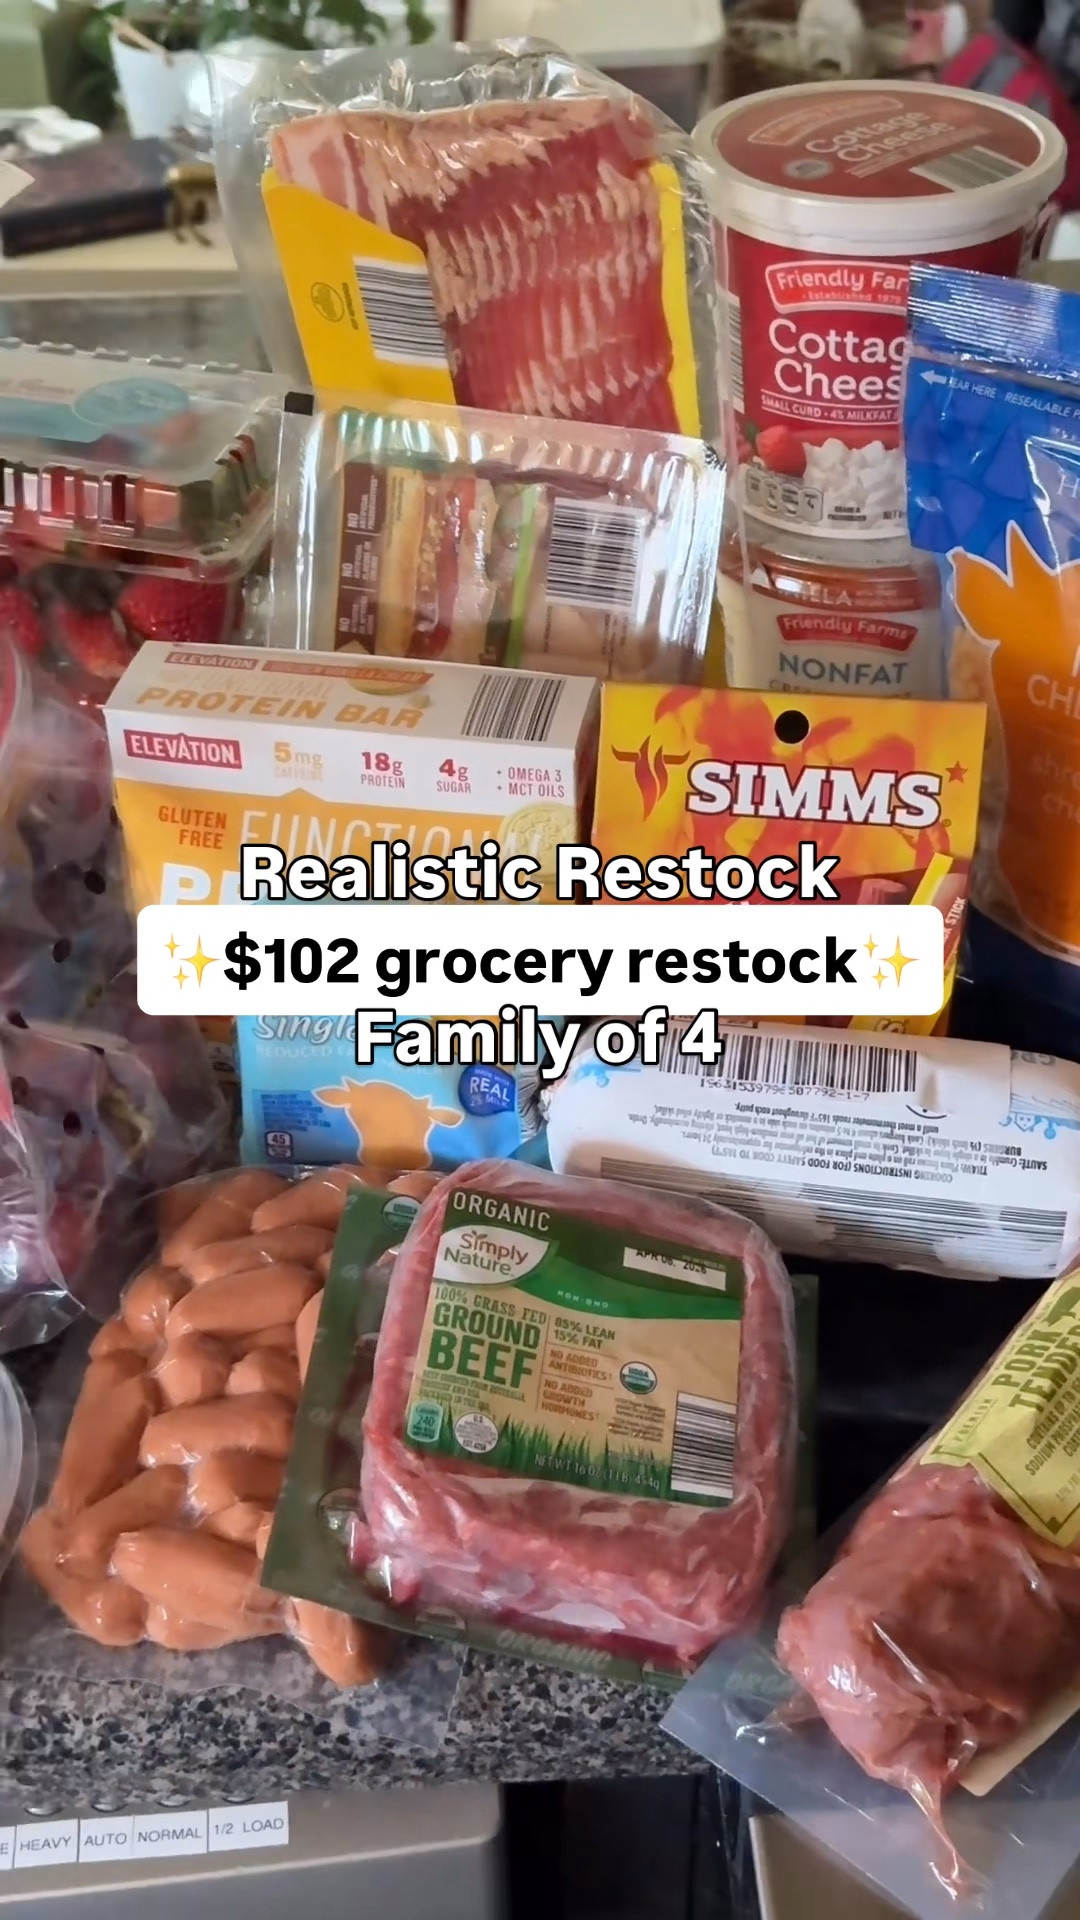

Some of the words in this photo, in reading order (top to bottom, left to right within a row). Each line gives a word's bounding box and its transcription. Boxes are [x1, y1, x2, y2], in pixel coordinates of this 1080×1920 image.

[806, 112, 930, 153] Cottage
[837, 122, 955, 162] Cheese
[776, 269, 864, 291] Friendly
[769, 318, 908, 371] Cottag
[774, 358, 903, 401] Chees
[761, 394, 790, 412] SMALL
[793, 403, 821, 418] CURD
[847, 408, 892, 421] MILKFAT
[971, 384, 998, 399] HERE
[1004, 391, 1070, 418] RESEALABLE
[784, 616, 852, 634] Friendly
[857, 621, 909, 640] Farms
[169, 653, 255, 669] ELEVATION
[778, 653, 909, 686] NONFAT
[137, 687, 327, 720] PROTEIN
[334, 704, 424, 729] BAR
[130, 734, 240, 765] ELEVATION
[361, 752, 404, 776] 18g
[438, 758, 469, 782] 4g
[507, 766, 551, 782] OMEGA
[554, 769, 563, 782] 3
[360, 774, 406, 789] PROTEIN
[436, 780, 471, 794] SUGAR
[508, 783, 534, 797] MCT
[537, 785, 566, 798] OILS
[686, 760, 943, 828] SIMMS
[157, 804, 227, 831] GLUTEN
[178, 829, 225, 851] FREE
[945, 896, 967, 925] STICK
[470, 1076, 511, 1102] REAL
[272, 1133, 286, 1145] 45
[807, 1157, 830, 1170] FOOD
[853, 1163, 912, 1180] INSTRUCTIONS
[452, 1192, 551, 1232] ORGANIC
[459, 1230, 529, 1266] Simply
[636, 1247, 659, 1262] APR
[443, 1247, 512, 1276] Nature
[434, 1286, 468, 1304] 100%
[473, 1294, 517, 1317] GRASS
[520, 1307, 548, 1325] FED
[433, 1302, 541, 1350] GROUND
[554, 1316, 582, 1333] 85%
[585, 1324, 616, 1341] LEAN
[553, 1328, 580, 1345] 15%
[582, 1335, 603, 1350] FAT
[427, 1329, 538, 1389] BEEF
[550, 1349, 564, 1361] NO
[565, 1352, 599, 1368] ADDED
[990, 1329, 1064, 1388] PORK
[542, 1389, 586, 1408] GROWTH
[544, 1378, 559, 1390] NO
[560, 1382, 593, 1398] ADDED
[416, 1415, 436, 1428] 240
[1026, 1410, 1060, 1450] CONTAINS
[1025, 1441, 1057, 1476] SODIUM
[136, 1826, 203, 1844] NORMAL
[213, 1822, 234, 1836] 1/2
[242, 1817, 285, 1834] LOAD
[19, 1836, 73, 1852] HEAVY
[83, 1832, 128, 1847] AUTO
